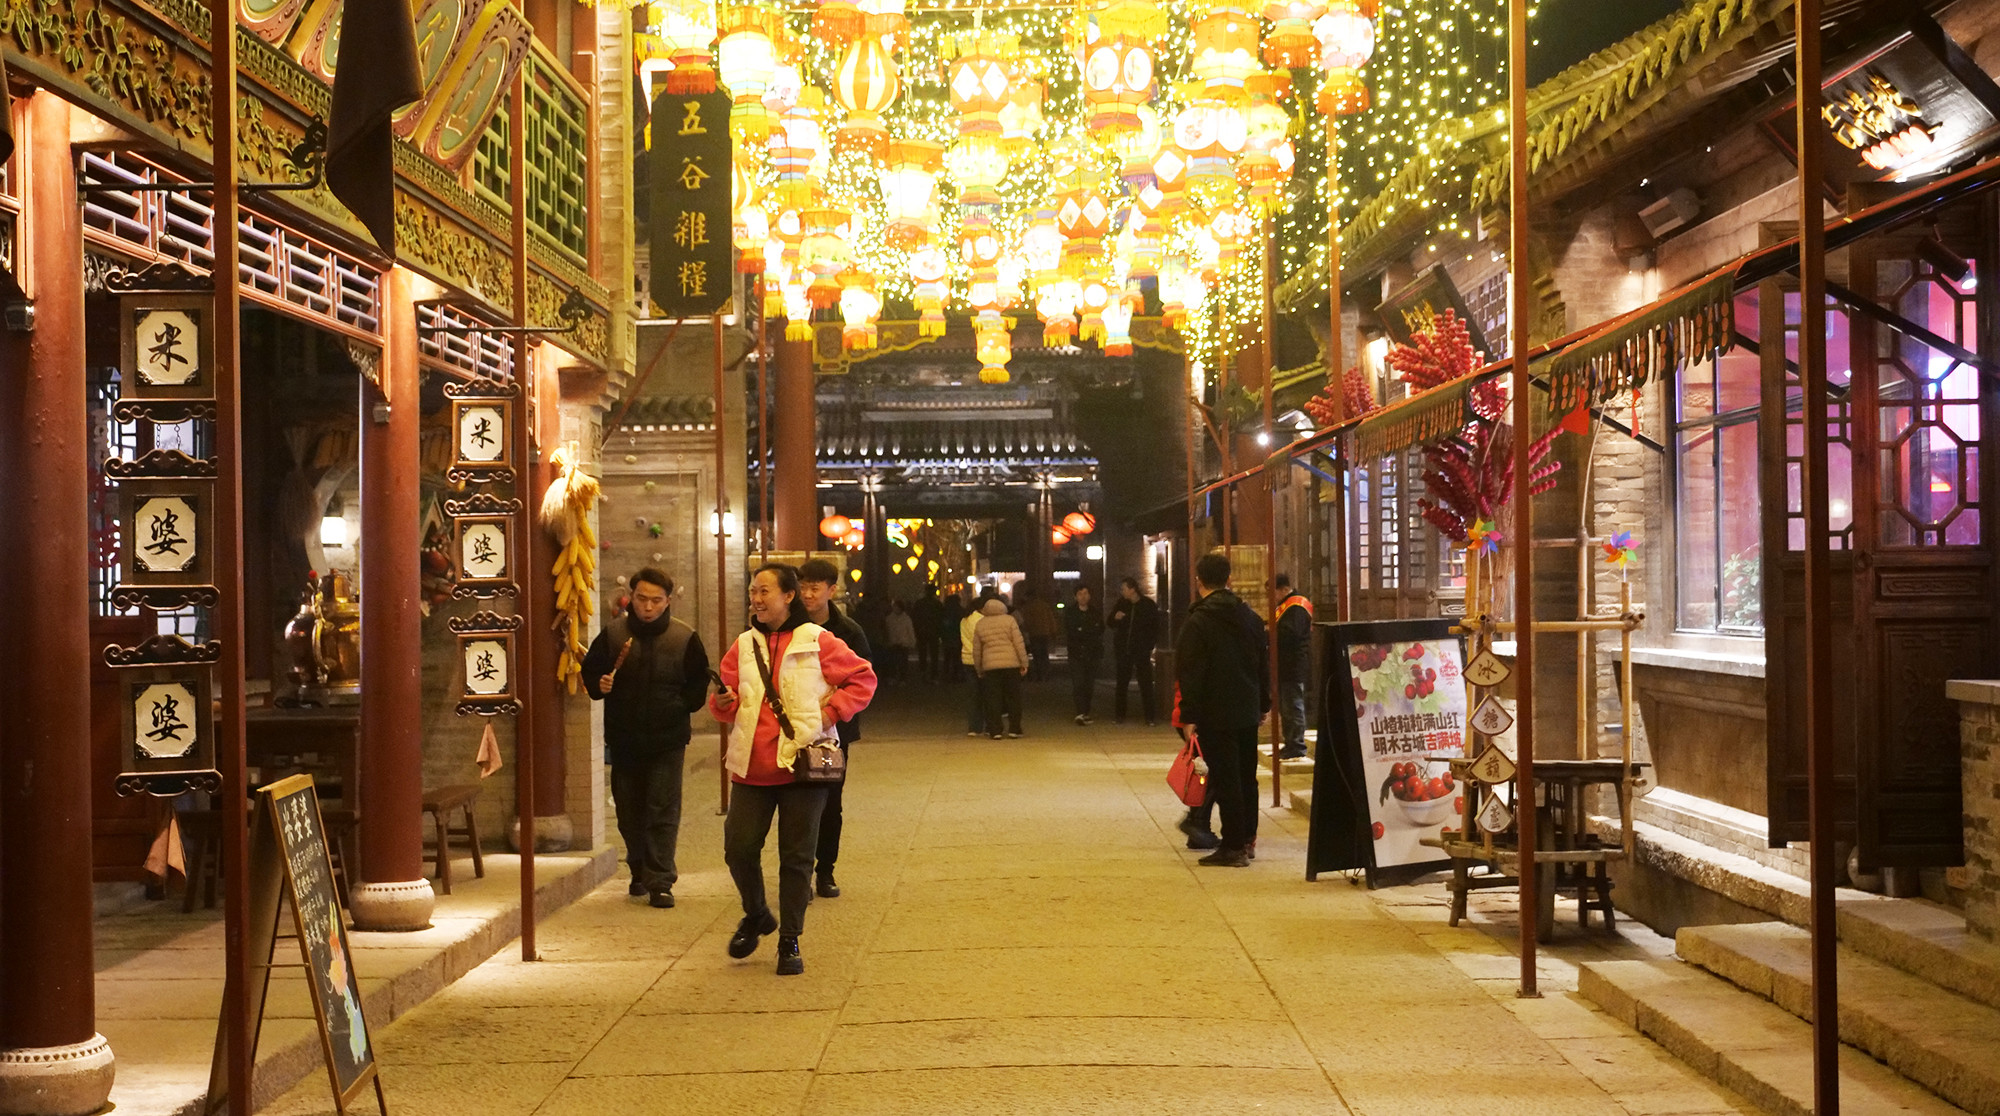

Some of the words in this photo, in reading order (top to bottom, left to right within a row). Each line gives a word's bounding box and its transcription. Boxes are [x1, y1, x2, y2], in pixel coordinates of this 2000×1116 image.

[673, 100, 711, 297] 五谷雜糧
[148, 322, 188, 372] 米
[470, 417, 495, 448] 米
[144, 509, 187, 555] 婆
[471, 533, 497, 564] 婆
[473, 650, 499, 679] 婆
[145, 694, 188, 741] 婆
